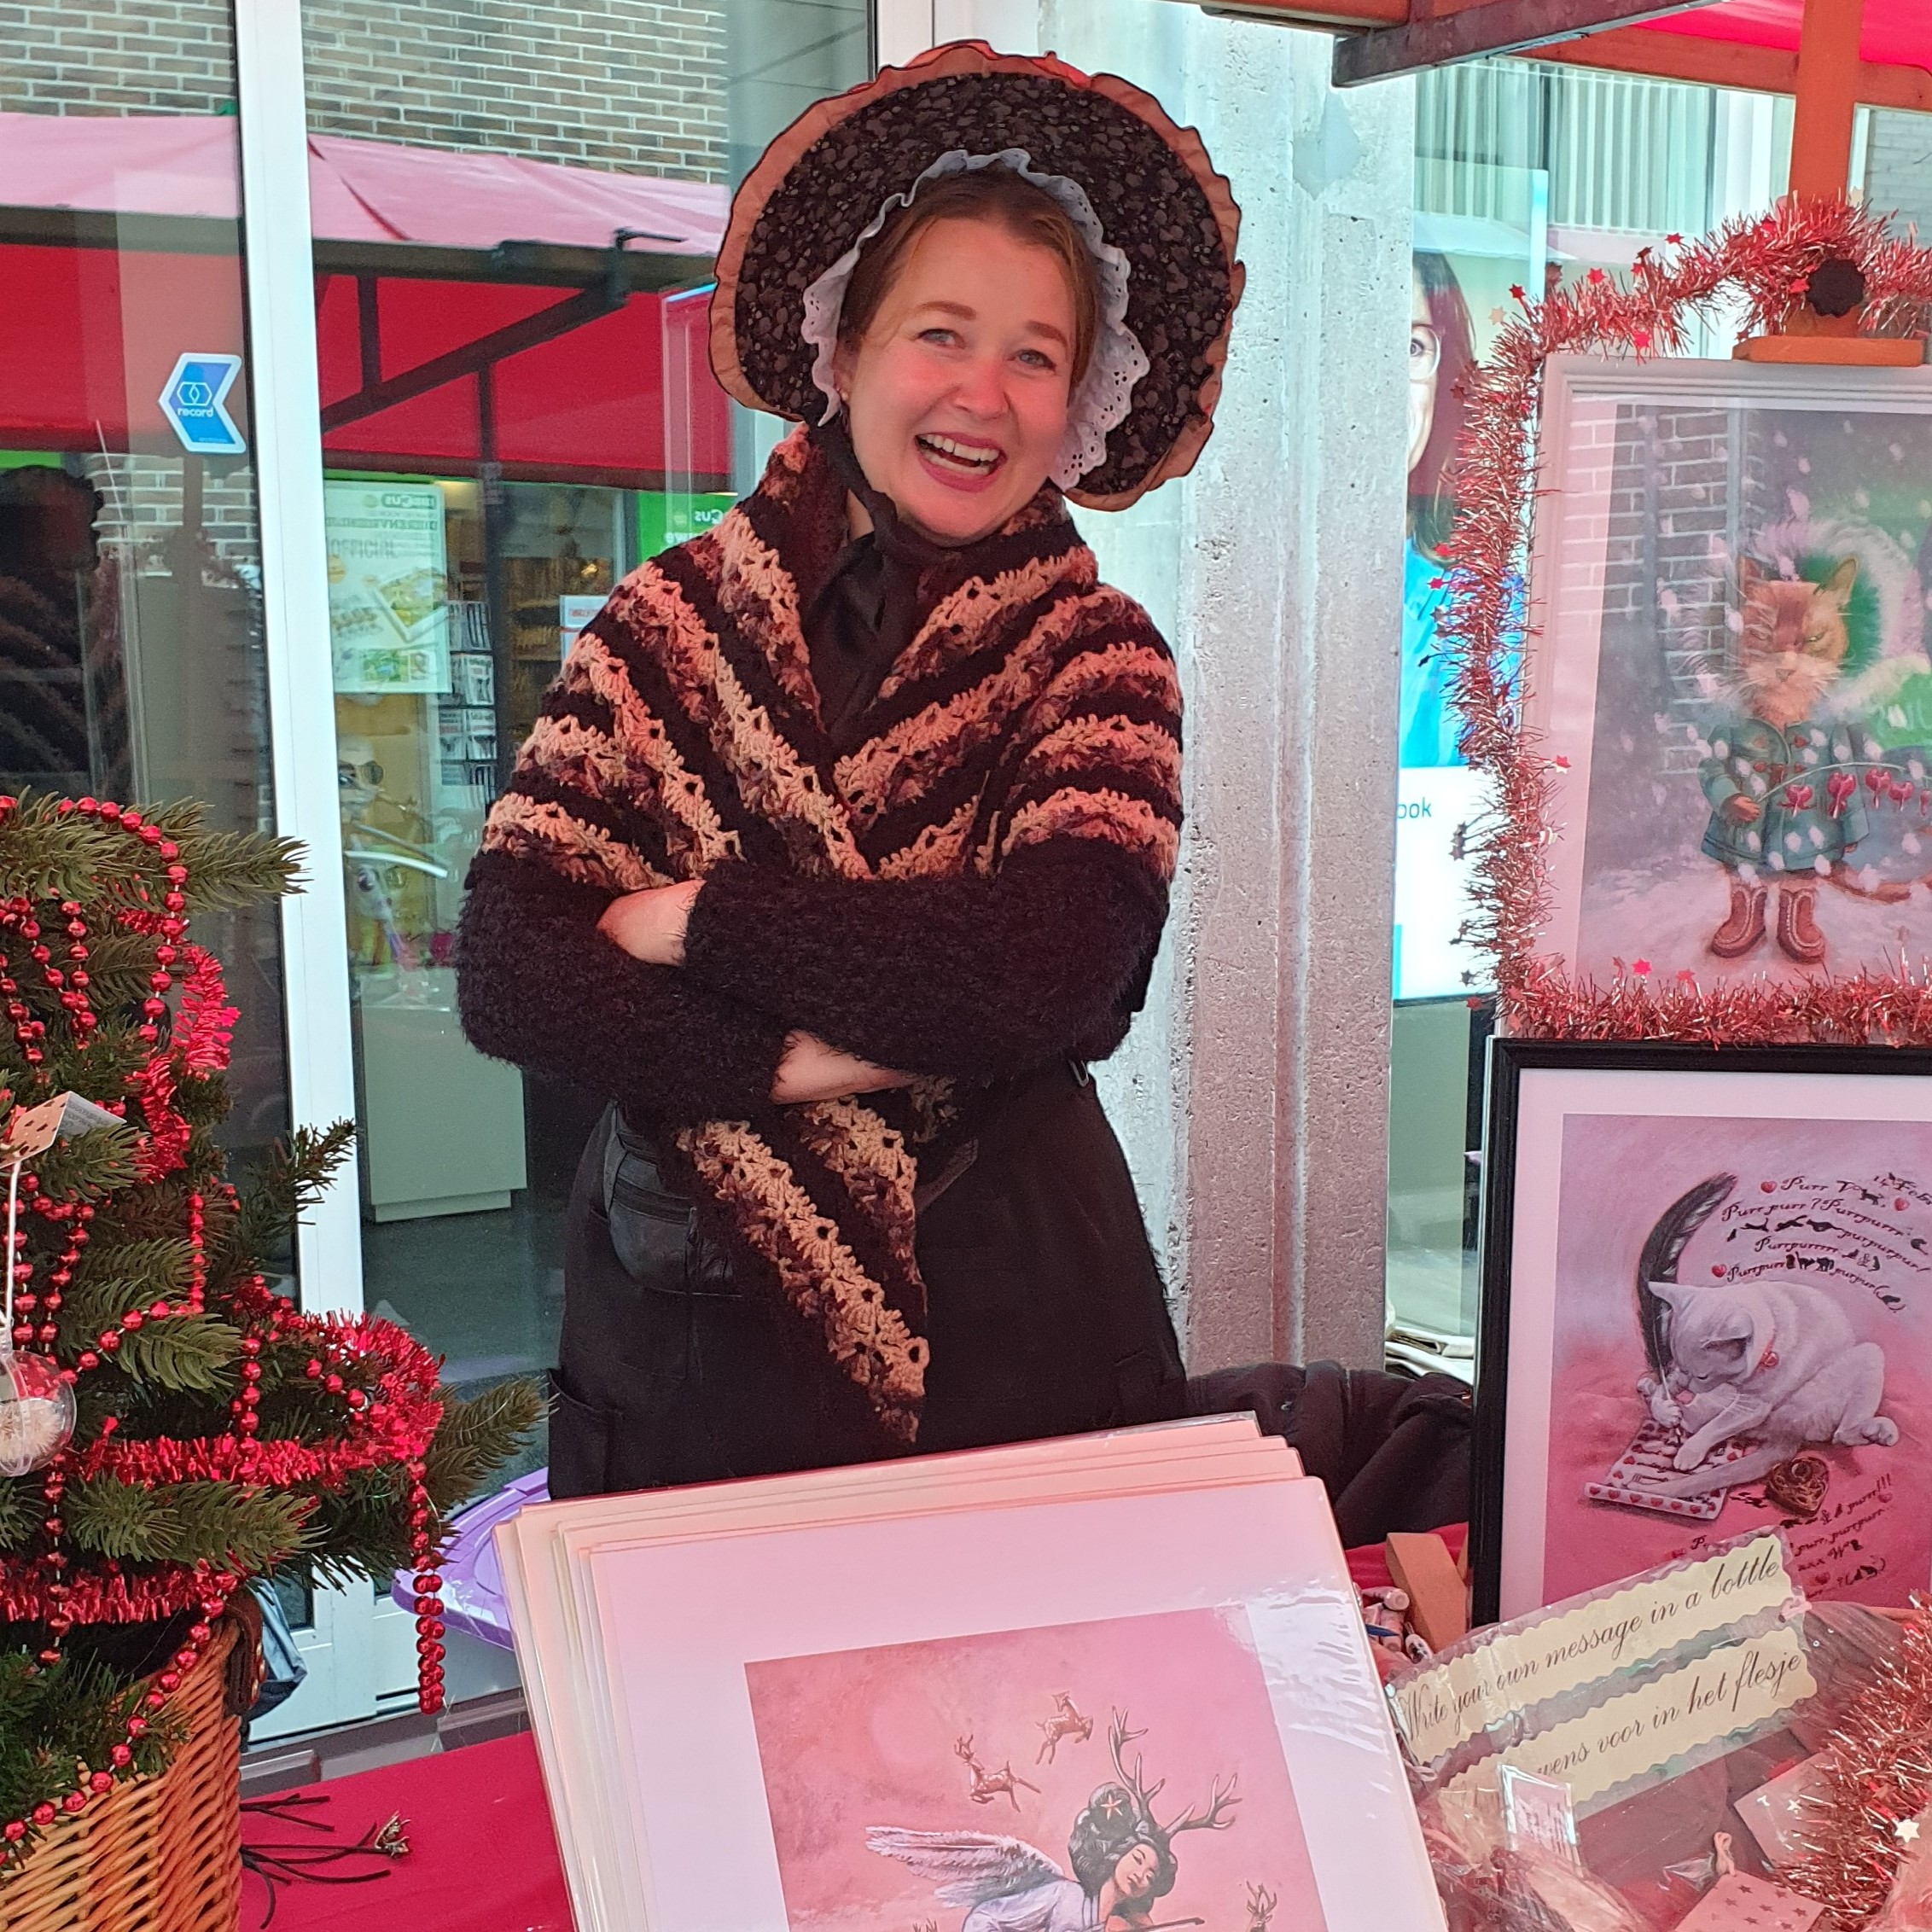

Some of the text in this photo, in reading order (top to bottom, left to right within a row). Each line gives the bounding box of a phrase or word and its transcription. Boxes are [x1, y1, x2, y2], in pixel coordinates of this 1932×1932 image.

[177, 406, 213, 417] record
[1399, 1684, 1449, 1741] Write
[1452, 1679, 1492, 1736] your
[1497, 1660, 1539, 1690] own
[1545, 1615, 1644, 1667] message
[1650, 1601, 1679, 1625] in
[1685, 1592, 1702, 1609] a
[1711, 1545, 1780, 1600] bottle
[1597, 1720, 1645, 1753] voor
[1652, 1706, 1680, 1730] in
[1687, 1672, 1728, 1714] het
[1731, 1650, 1802, 1713] flesje
